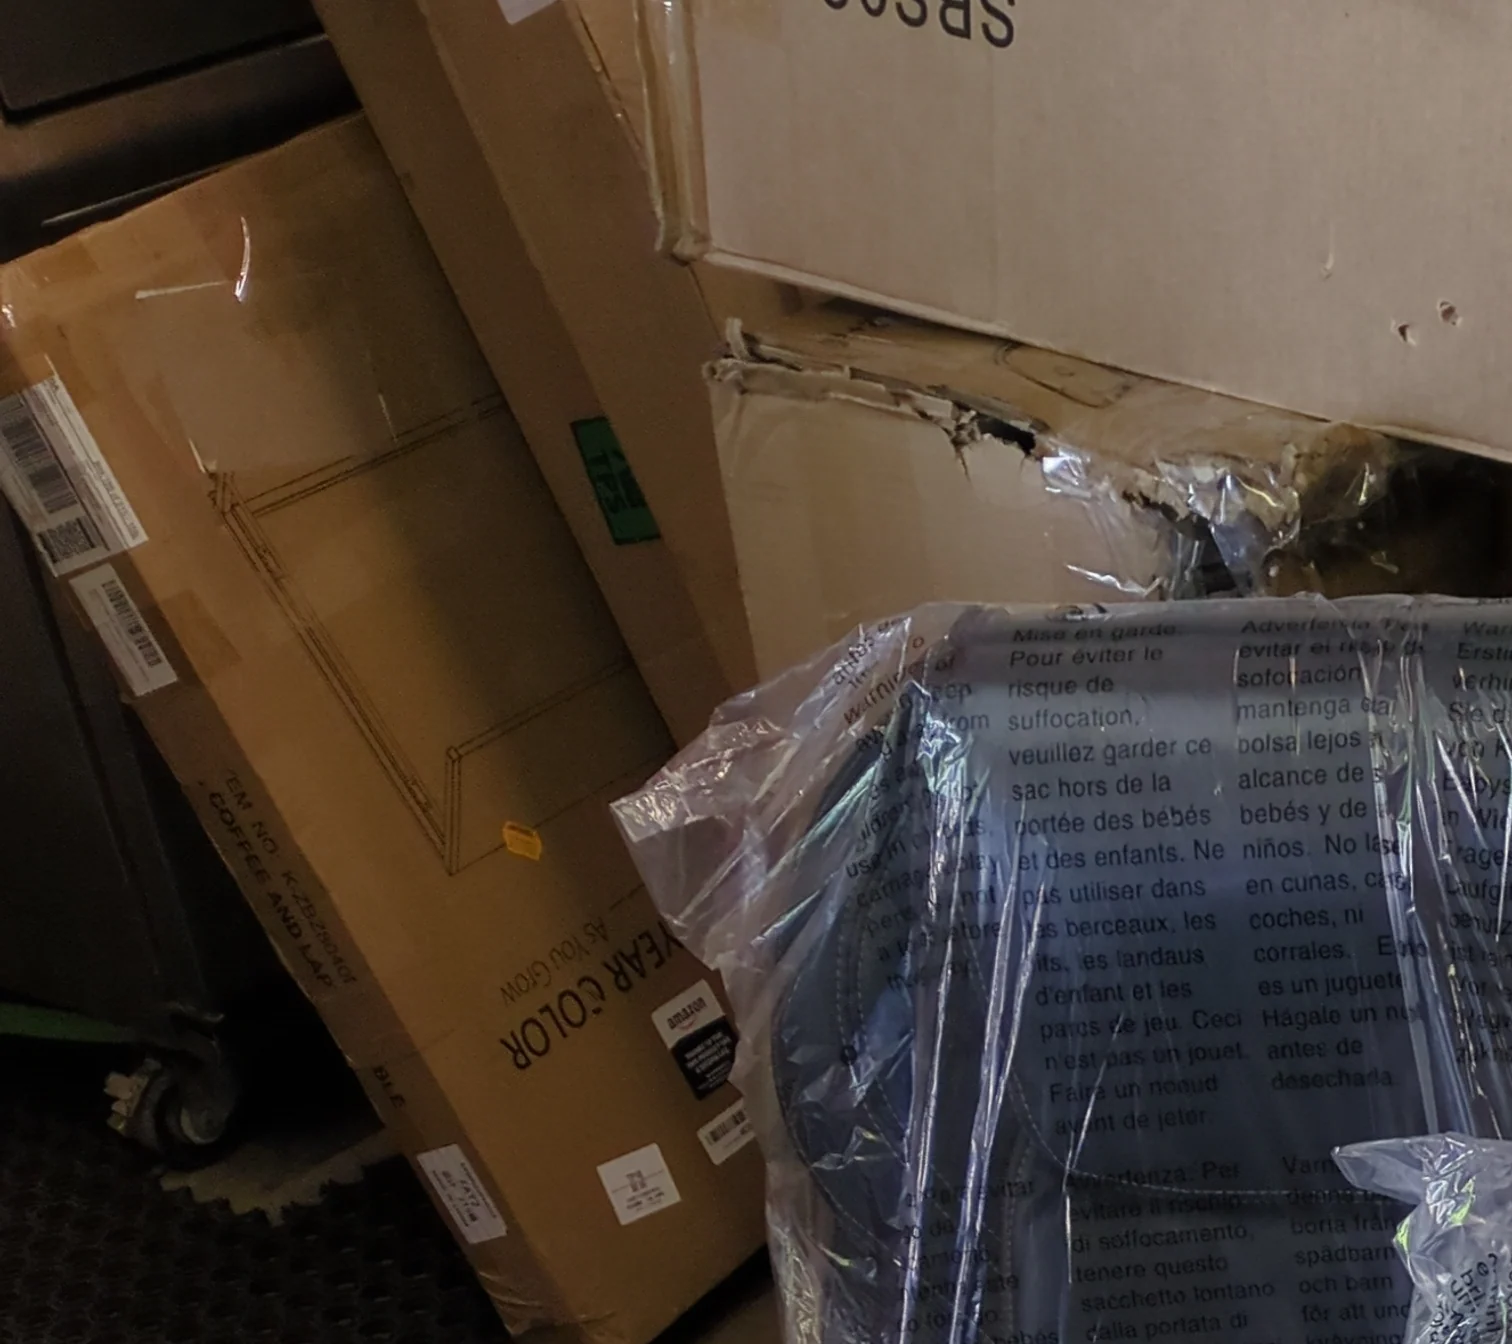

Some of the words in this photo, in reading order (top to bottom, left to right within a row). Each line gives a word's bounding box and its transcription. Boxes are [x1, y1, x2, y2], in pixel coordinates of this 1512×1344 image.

[1013, 629, 1065, 641] Mise
[1075, 629, 1101, 640] en
[1010, 650, 1063, 667] Pour
[1072, 648, 1136, 664] éviter
[1144, 646, 1163, 661] le
[1239, 641, 1301, 659] evitar
[1007, 681, 1077, 699] risque
[1086, 676, 1114, 693] de
[1237, 698, 1350, 720] mantenga
[1008, 742, 1094, 766] veuillez
[1103, 738, 1177, 766] garder
[1186, 737, 1212, 754] ce
[1238, 734, 1298, 754] bolsa
[1307, 729, 1361, 754] lejos
[1011, 782, 1050, 801] sac
[1058, 777, 1107, 797] hors
[1116, 774, 1143, 794] de
[1152, 772, 1172, 792] la
[1238, 768, 1328, 789] alcance
[1336, 762, 1365, 783] de
[1014, 812, 1085, 836] portée
[1094, 810, 1134, 831] des
[1141, 804, 1212, 828] bébés
[1240, 801, 1309, 825] bebés
[1317, 804, 1330, 826] y
[1339, 798, 1367, 818] de
[1018, 852, 1038, 871] et
[1045, 851, 1086, 870] des
[1094, 841, 1186, 867] enfants.
[1193, 838, 1225, 860] Ne
[1324, 834, 1356, 855] No
[209, 792, 270, 885] COFFEE
[267, 891, 302, 940] AND
[300, 943, 336, 988] LAP
[1069, 881, 1143, 903] utiliser
[1151, 877, 1206, 898] dans
[1246, 878, 1273, 895] en
[1282, 873, 1357, 893] cunas,
[583, 916, 609, 944] As
[1066, 914, 1176, 937] berceaux,
[1184, 911, 1217, 931] les
[1249, 907, 1337, 929] coches,
[1345, 907, 1364, 925] ni
[549, 936, 590, 970] You
[603, 920, 684, 992] YEAR
[1117, 947, 1205, 968] landaus
[500, 959, 552, 1006] Grow
[1133, 982, 1153, 999] et
[1161, 980, 1193, 998] les
[1258, 980, 1284, 997] es
[1291, 977, 1319, 994] un
[499, 976, 606, 1070] COLOR
[667, 997, 707, 1030] amazon
[1040, 1019, 1101, 1043] parcs
[1109, 1014, 1136, 1034] de
[1192, 1009, 1242, 1029] Ceci
[1351, 1006, 1377, 1022] un
[1106, 1048, 1145, 1068] pas
[1152, 1045, 1180, 1063] un
[1267, 1041, 1327, 1060] antes
[1336, 1038, 1364, 1056] de
[1114, 1081, 1141, 1098] un
[1123, 1111, 1149, 1130] de
[1076, 1263, 1145, 1283] tenere
[1154, 1253, 1228, 1281] questo
[1081, 1289, 1186, 1312] sacchetto
[1192, 1281, 1275, 1303] lontano
[1086, 1321, 1137, 1341] dalla
[1145, 1315, 1222, 1340] portata
[1229, 1310, 1248, 1329] di
